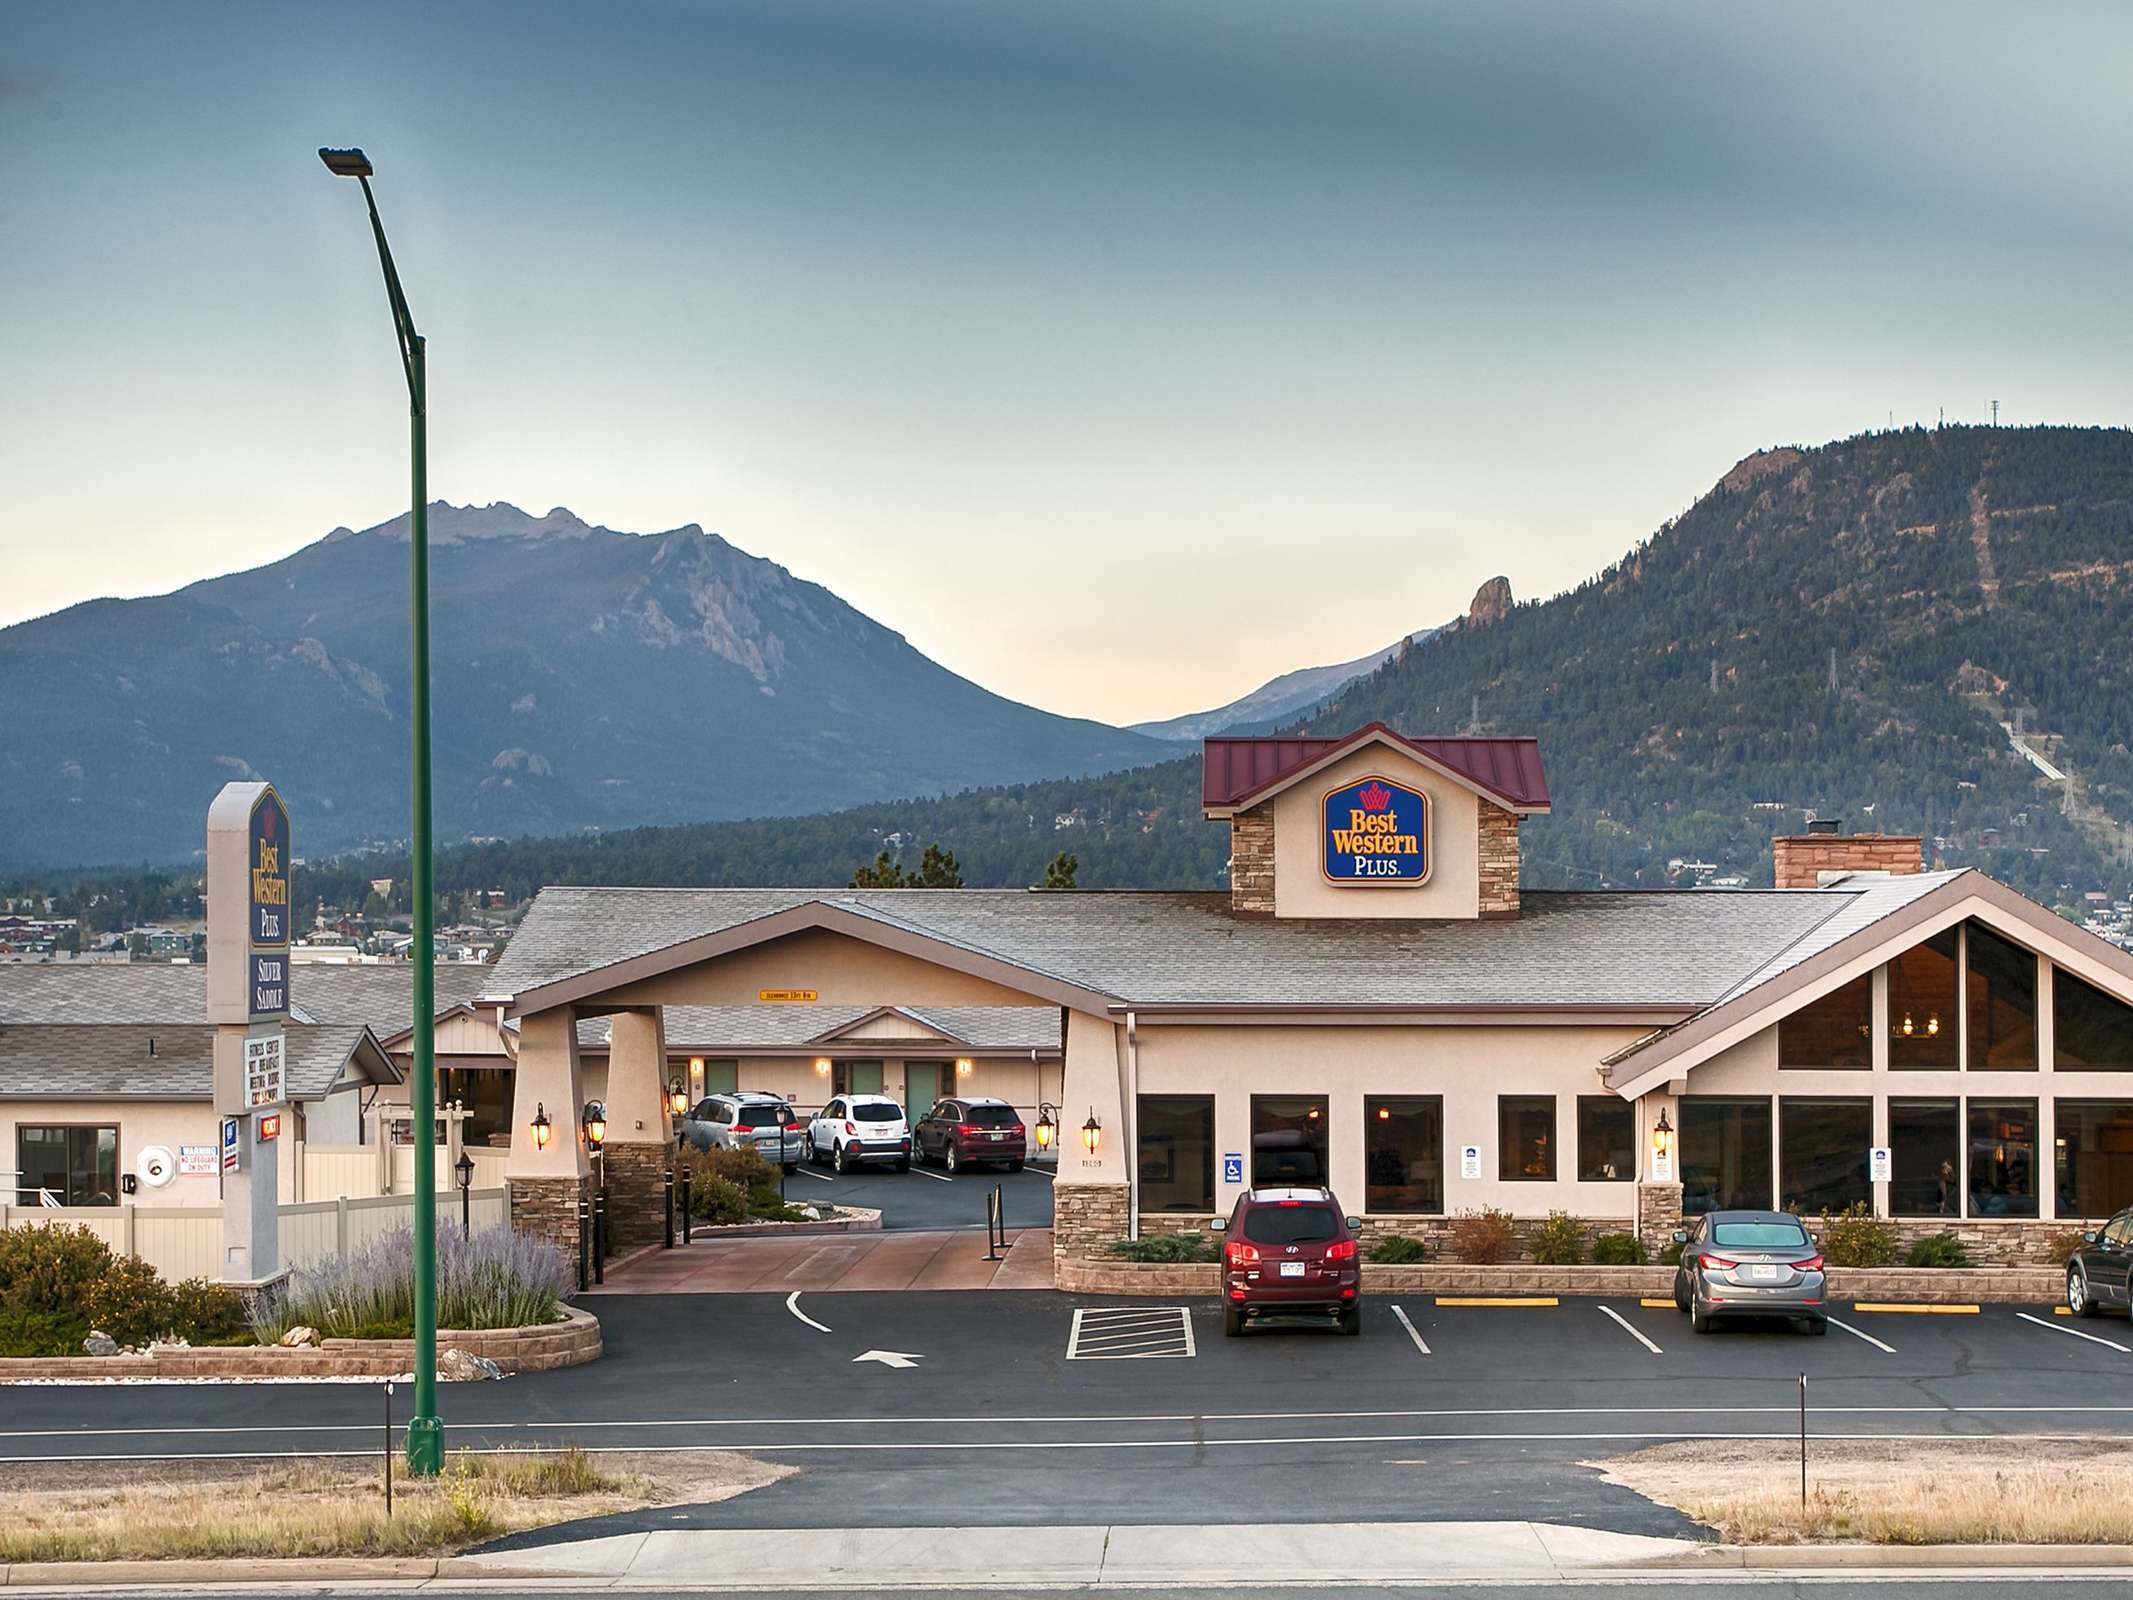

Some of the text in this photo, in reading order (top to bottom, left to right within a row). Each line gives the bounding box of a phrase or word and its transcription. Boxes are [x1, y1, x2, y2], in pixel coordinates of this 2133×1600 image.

[1350, 809, 1398, 833] Best
[1332, 828, 1418, 854] Western
[260, 838, 279, 873] Best
[253, 868, 287, 905] Western
[258, 958, 281, 982] SILVER
[257, 986, 283, 1010] SADDLE
[190, 1156, 217, 1164] LIFEGUARD
